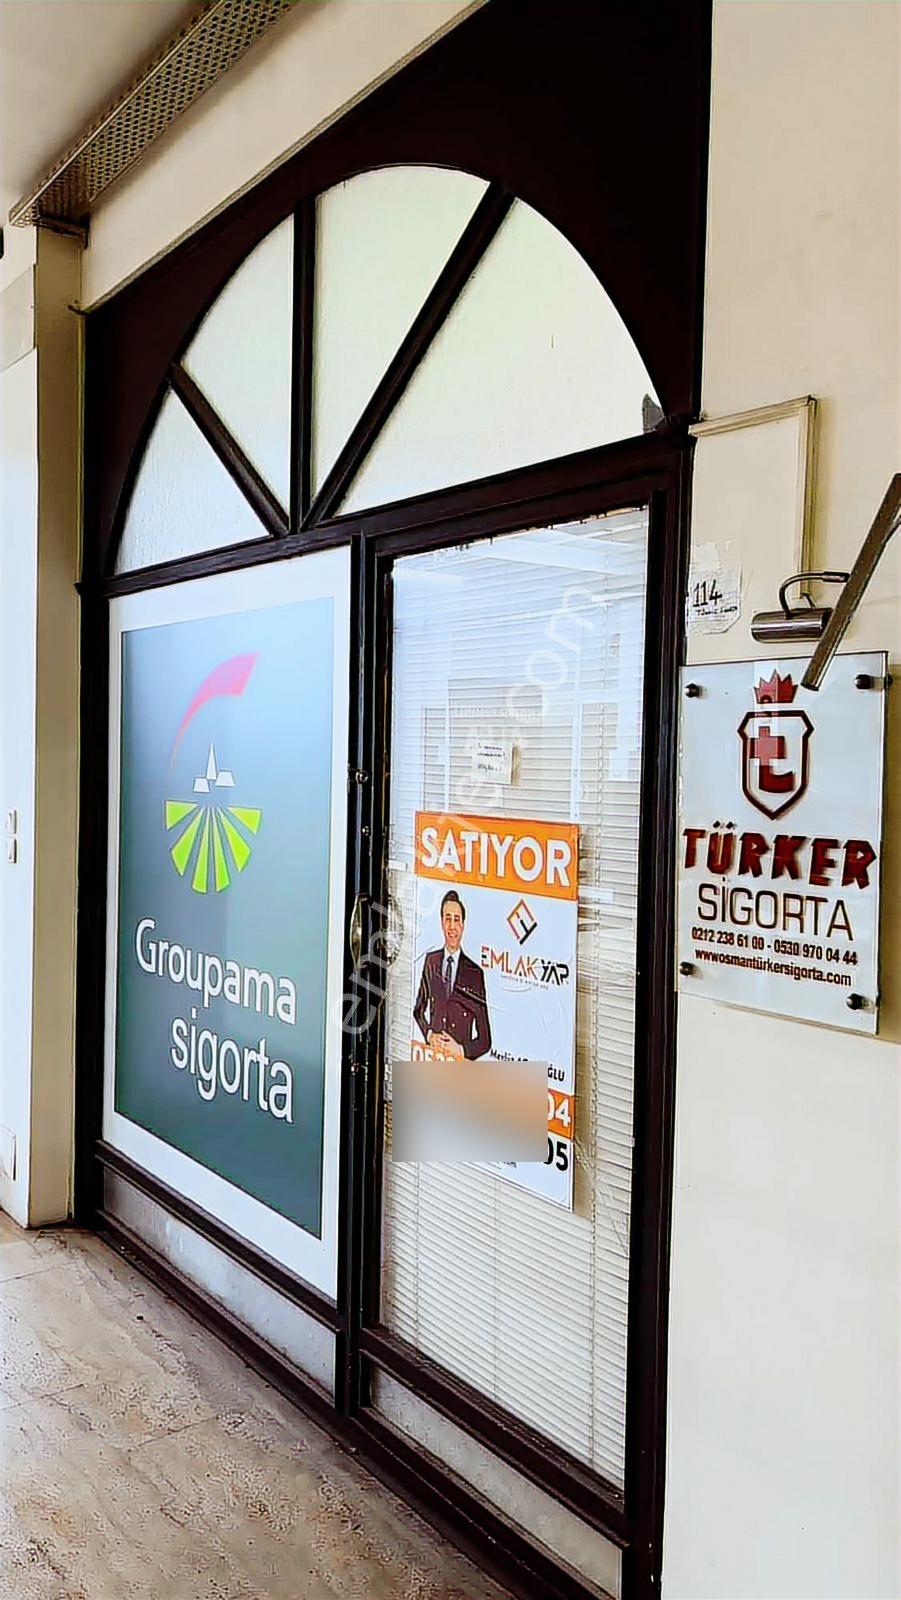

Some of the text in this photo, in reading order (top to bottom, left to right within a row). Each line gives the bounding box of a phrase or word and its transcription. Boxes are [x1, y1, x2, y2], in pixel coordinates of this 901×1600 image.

[693, 579, 723, 607] 114
[421, 827, 571, 887] SATIYOR
[683, 821, 877, 889] TÜRKER
[698, 877, 853, 941] SİGORTA
[136, 918, 296, 1025] Groupama
[692, 927, 715, 942] 0212
[717, 931, 735, 946] 238
[737, 933, 749, 948] 61
[752, 937, 765, 950] 00
[774, 939, 800, 956] 0530
[803, 943, 823, 960] 970
[826, 947, 840, 963] 04
[843, 951, 858, 966] 44
[171, 1007, 294, 1124] sigorta
